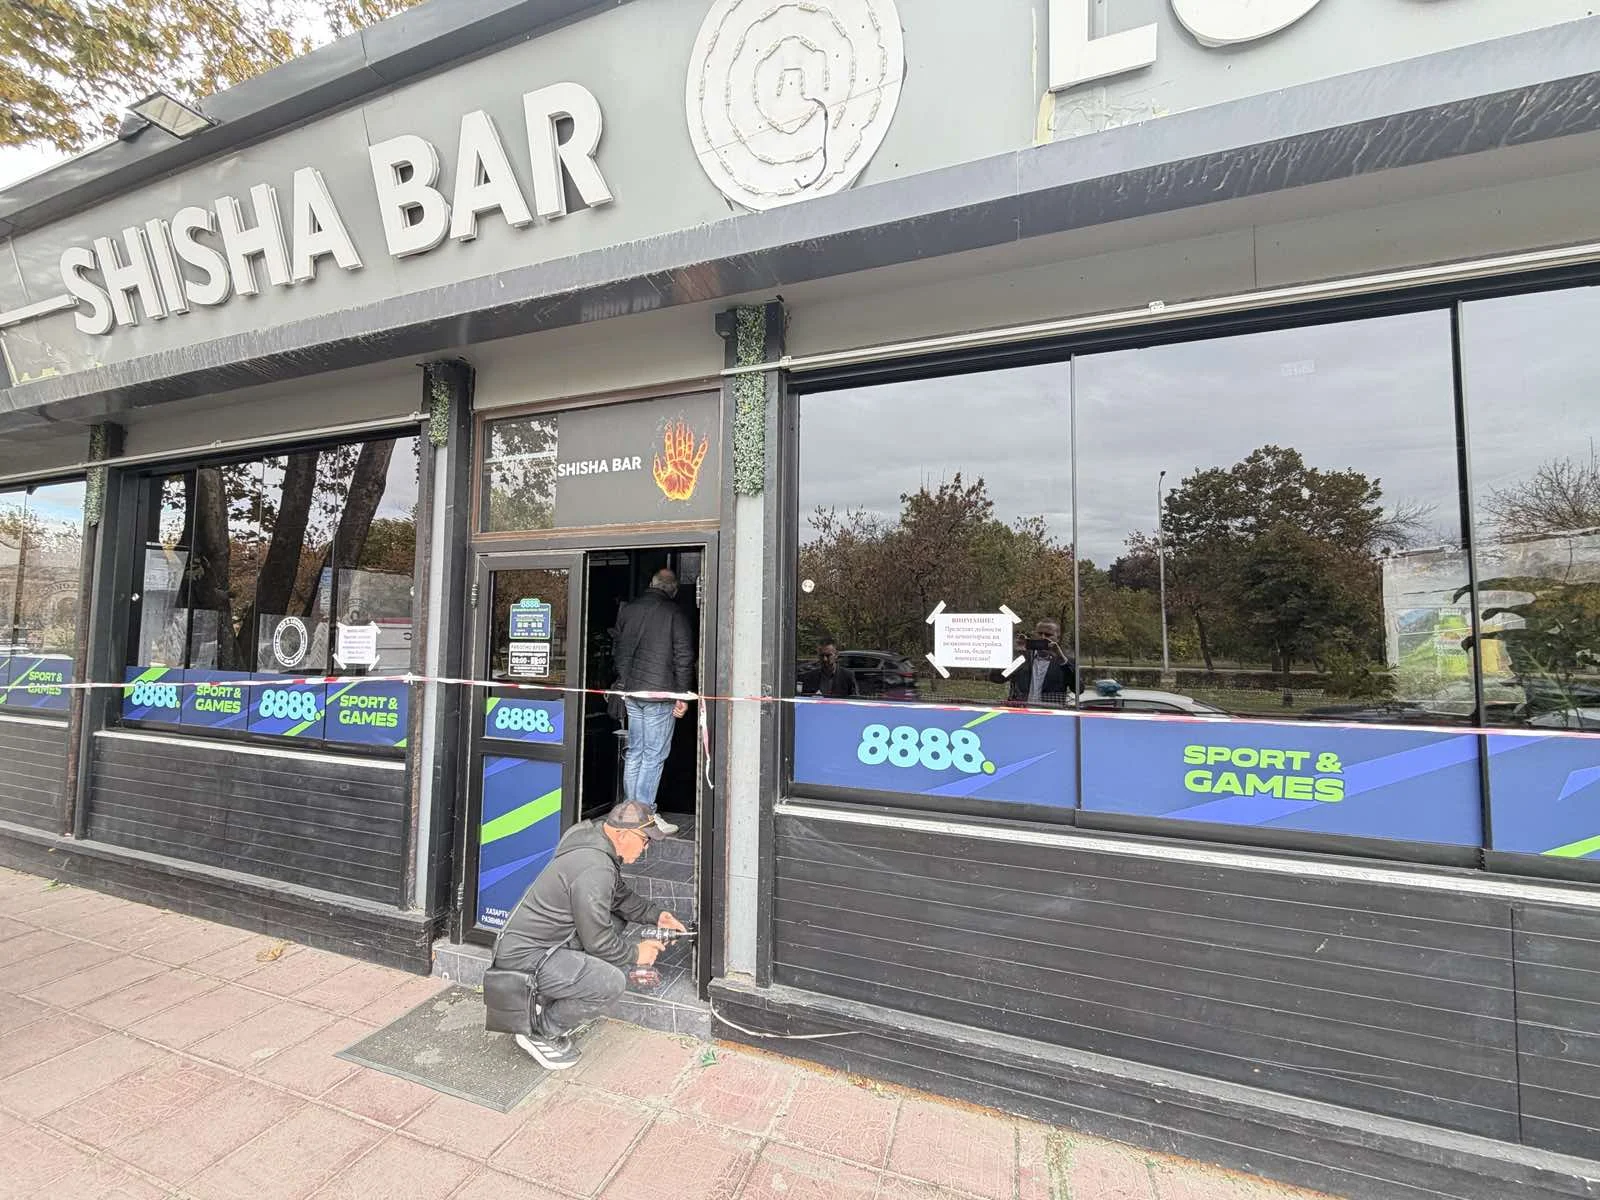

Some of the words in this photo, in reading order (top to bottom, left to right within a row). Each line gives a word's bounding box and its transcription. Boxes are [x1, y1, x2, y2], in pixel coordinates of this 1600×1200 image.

[60, 166, 364, 337] SHISHA
[369, 82, 616, 259] BAR
[557, 459, 609, 477] SHISHA
[612, 456, 642, 472] BAR
[29, 671, 57, 682] SPORT
[56, 672, 63, 682] &
[196, 684, 233, 699] SPORT
[233, 687, 241, 698] &
[195, 699, 241, 713] GAMES
[339, 694, 388, 709] SPORT
[387, 697, 399, 710] &
[339, 710, 398, 727] GAMES
[1183, 745, 1311, 771] SPORT
[1314, 752, 1343, 774] &
[1184, 769, 1345, 803] GAMES
